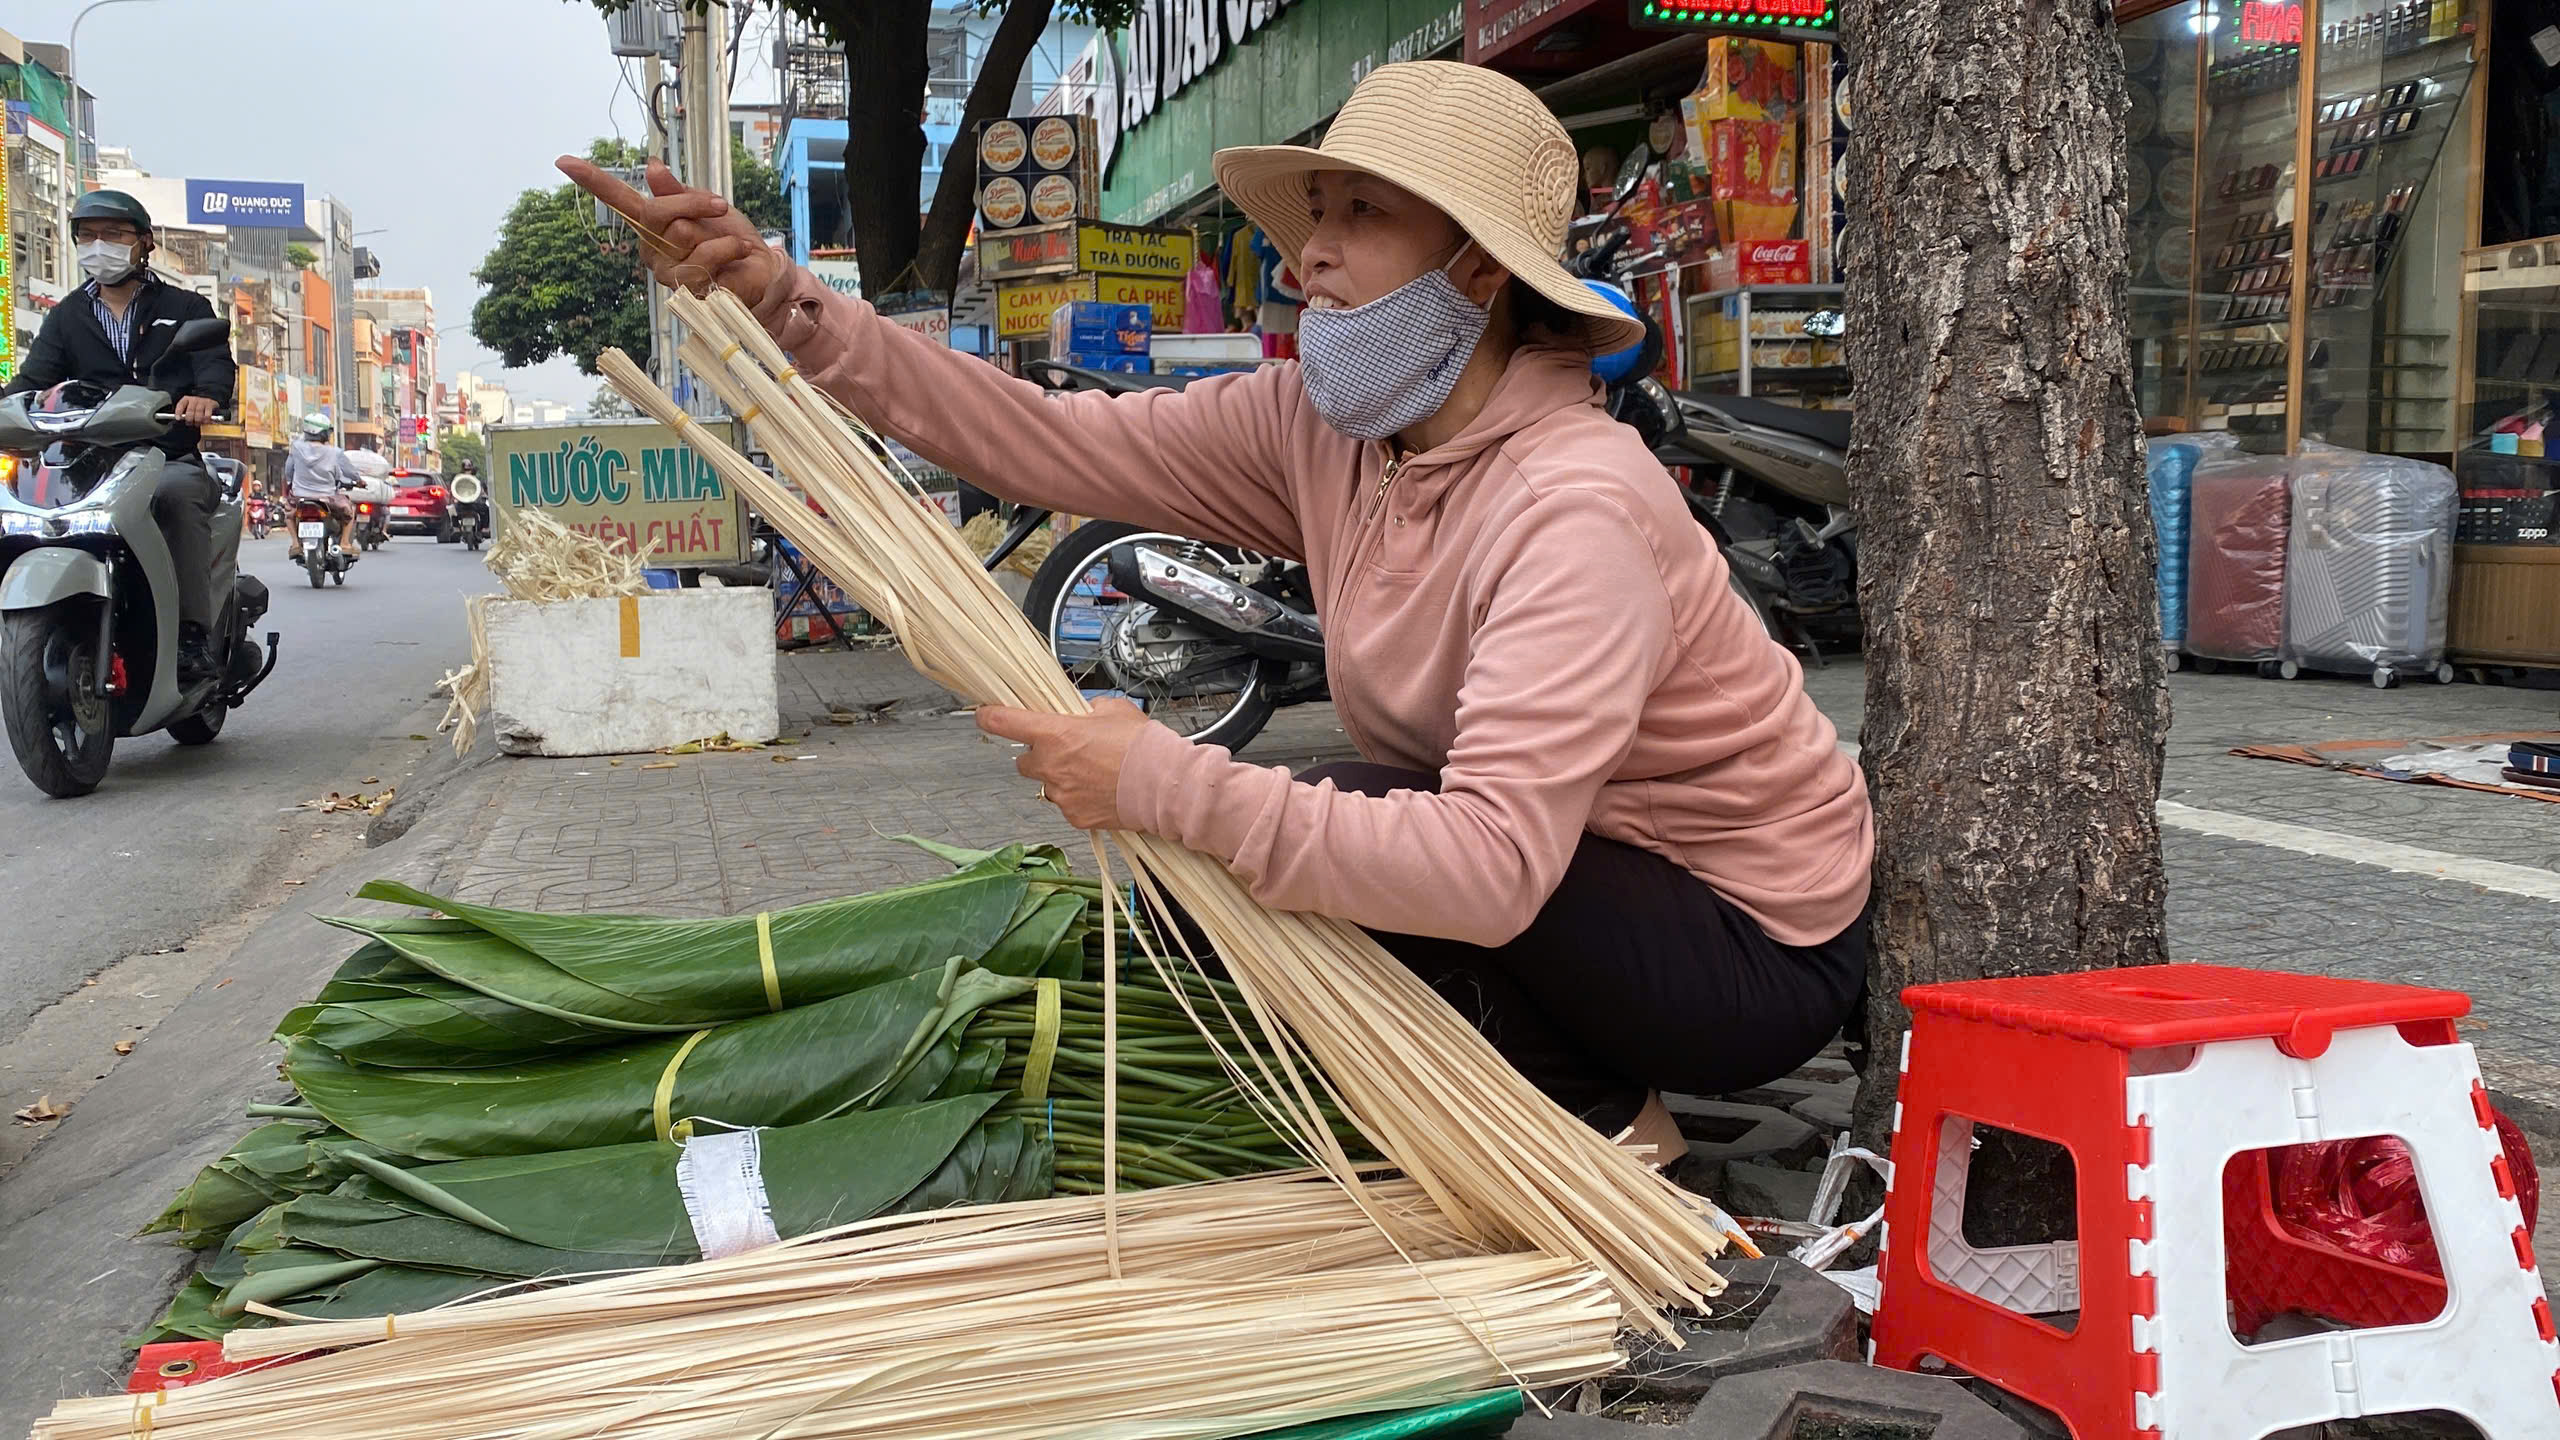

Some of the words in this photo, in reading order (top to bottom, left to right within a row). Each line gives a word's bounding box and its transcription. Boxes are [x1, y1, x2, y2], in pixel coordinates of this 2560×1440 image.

[231, 196, 268, 207] QUANG
[1008, 292, 1043, 309] CAM
[508, 435, 630, 507] NƯỚC
[647, 508, 724, 554] CHẤT
